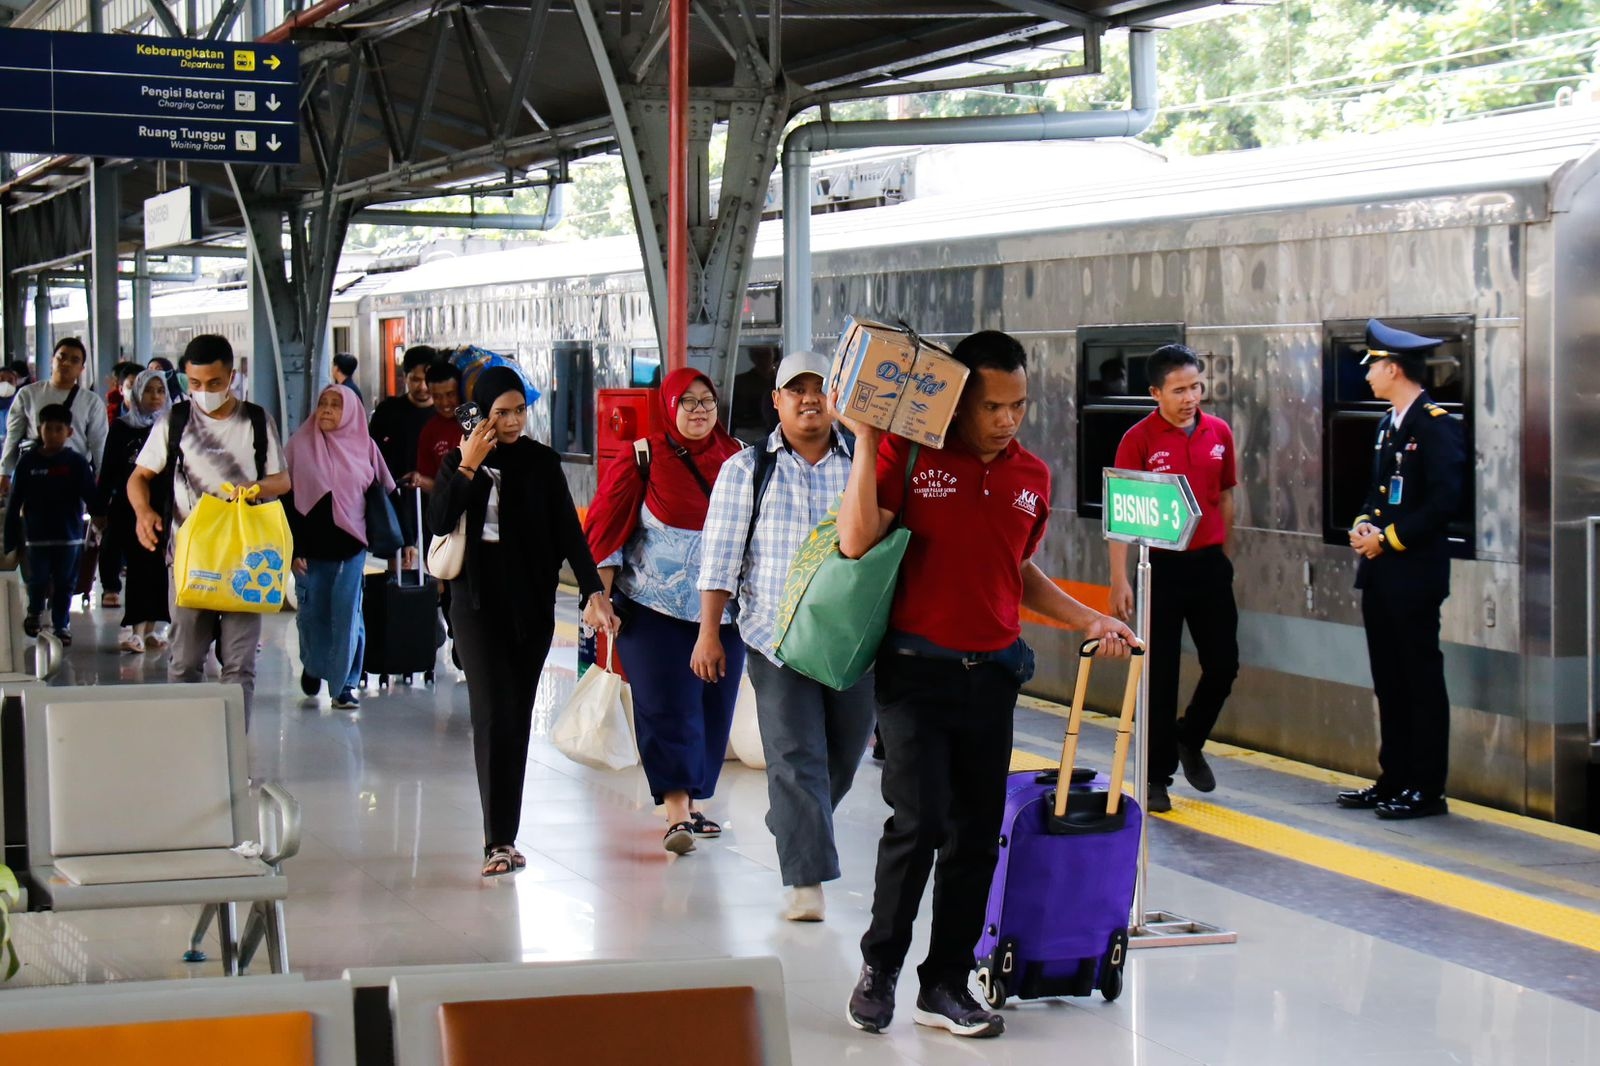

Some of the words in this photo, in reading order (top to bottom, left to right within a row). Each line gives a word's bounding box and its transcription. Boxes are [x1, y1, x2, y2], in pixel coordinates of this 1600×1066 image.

[136, 44, 224, 60] Keberangkatan
[180, 59, 225, 69] Departures
[141, 85, 182, 99] Pengisi
[185, 88, 225, 100] Baterai
[158, 99, 195, 110] Charging
[196, 101, 224, 110] Corner
[139, 125, 177, 140] Ruang
[180, 127, 226, 142] Tunggu
[170, 140, 201, 151] Waiting
[203, 142, 226, 151] Room
[912, 469, 957, 485] PORTER
[927, 480, 942, 488] 146
[1113, 492, 1160, 527] BISNIS
[1162, 513, 1169, 521] -
[1171, 499, 1180, 530] 3
